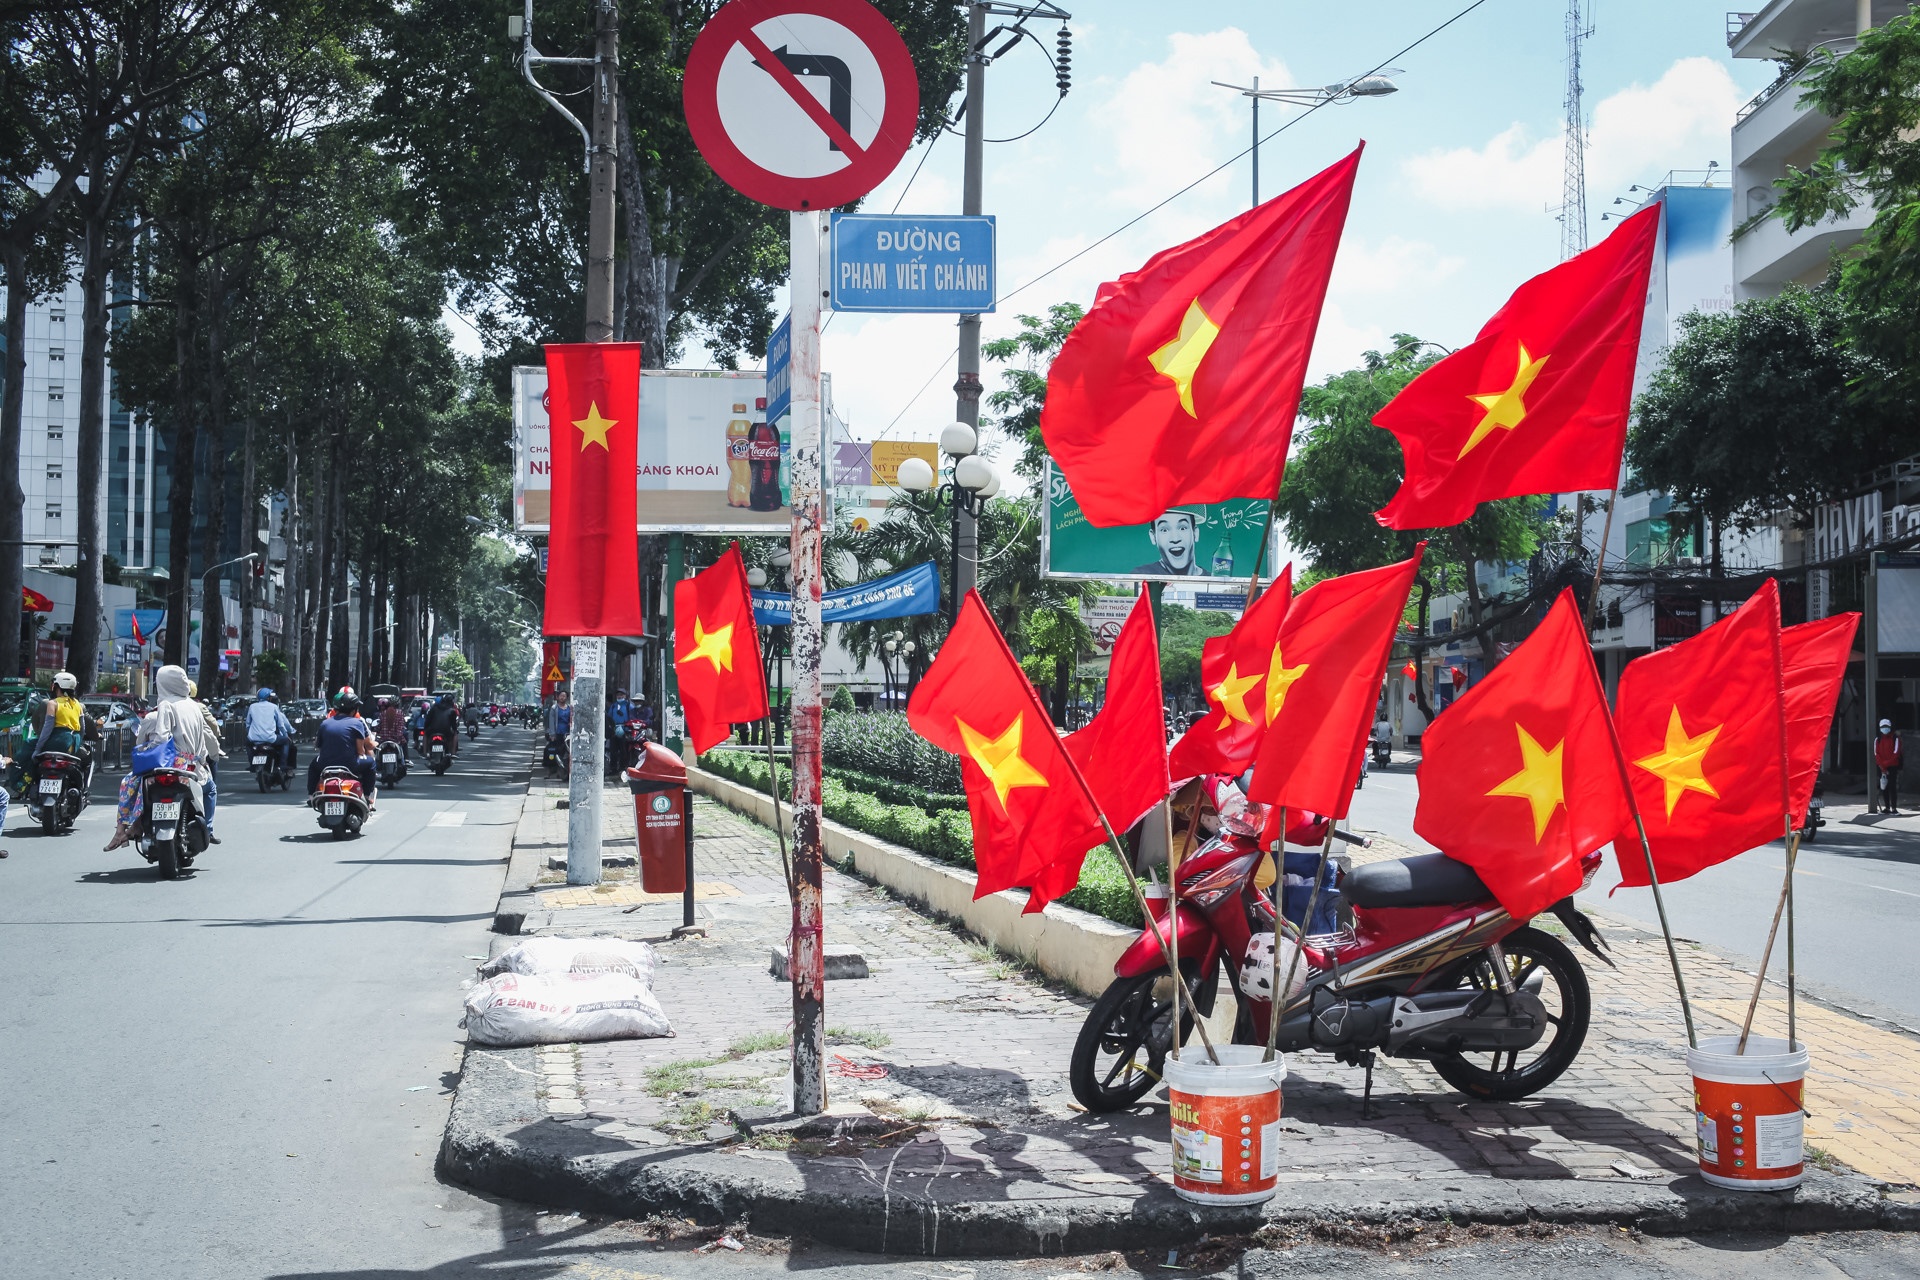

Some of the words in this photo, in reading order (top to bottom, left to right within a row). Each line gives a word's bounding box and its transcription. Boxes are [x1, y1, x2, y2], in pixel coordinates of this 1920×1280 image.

[877, 226, 961, 251] ĐƯỜNG
[841, 262, 887, 293] PHẠM
[896, 255, 928, 290] VIẾT
[935, 258, 987, 291] CHÁNH
